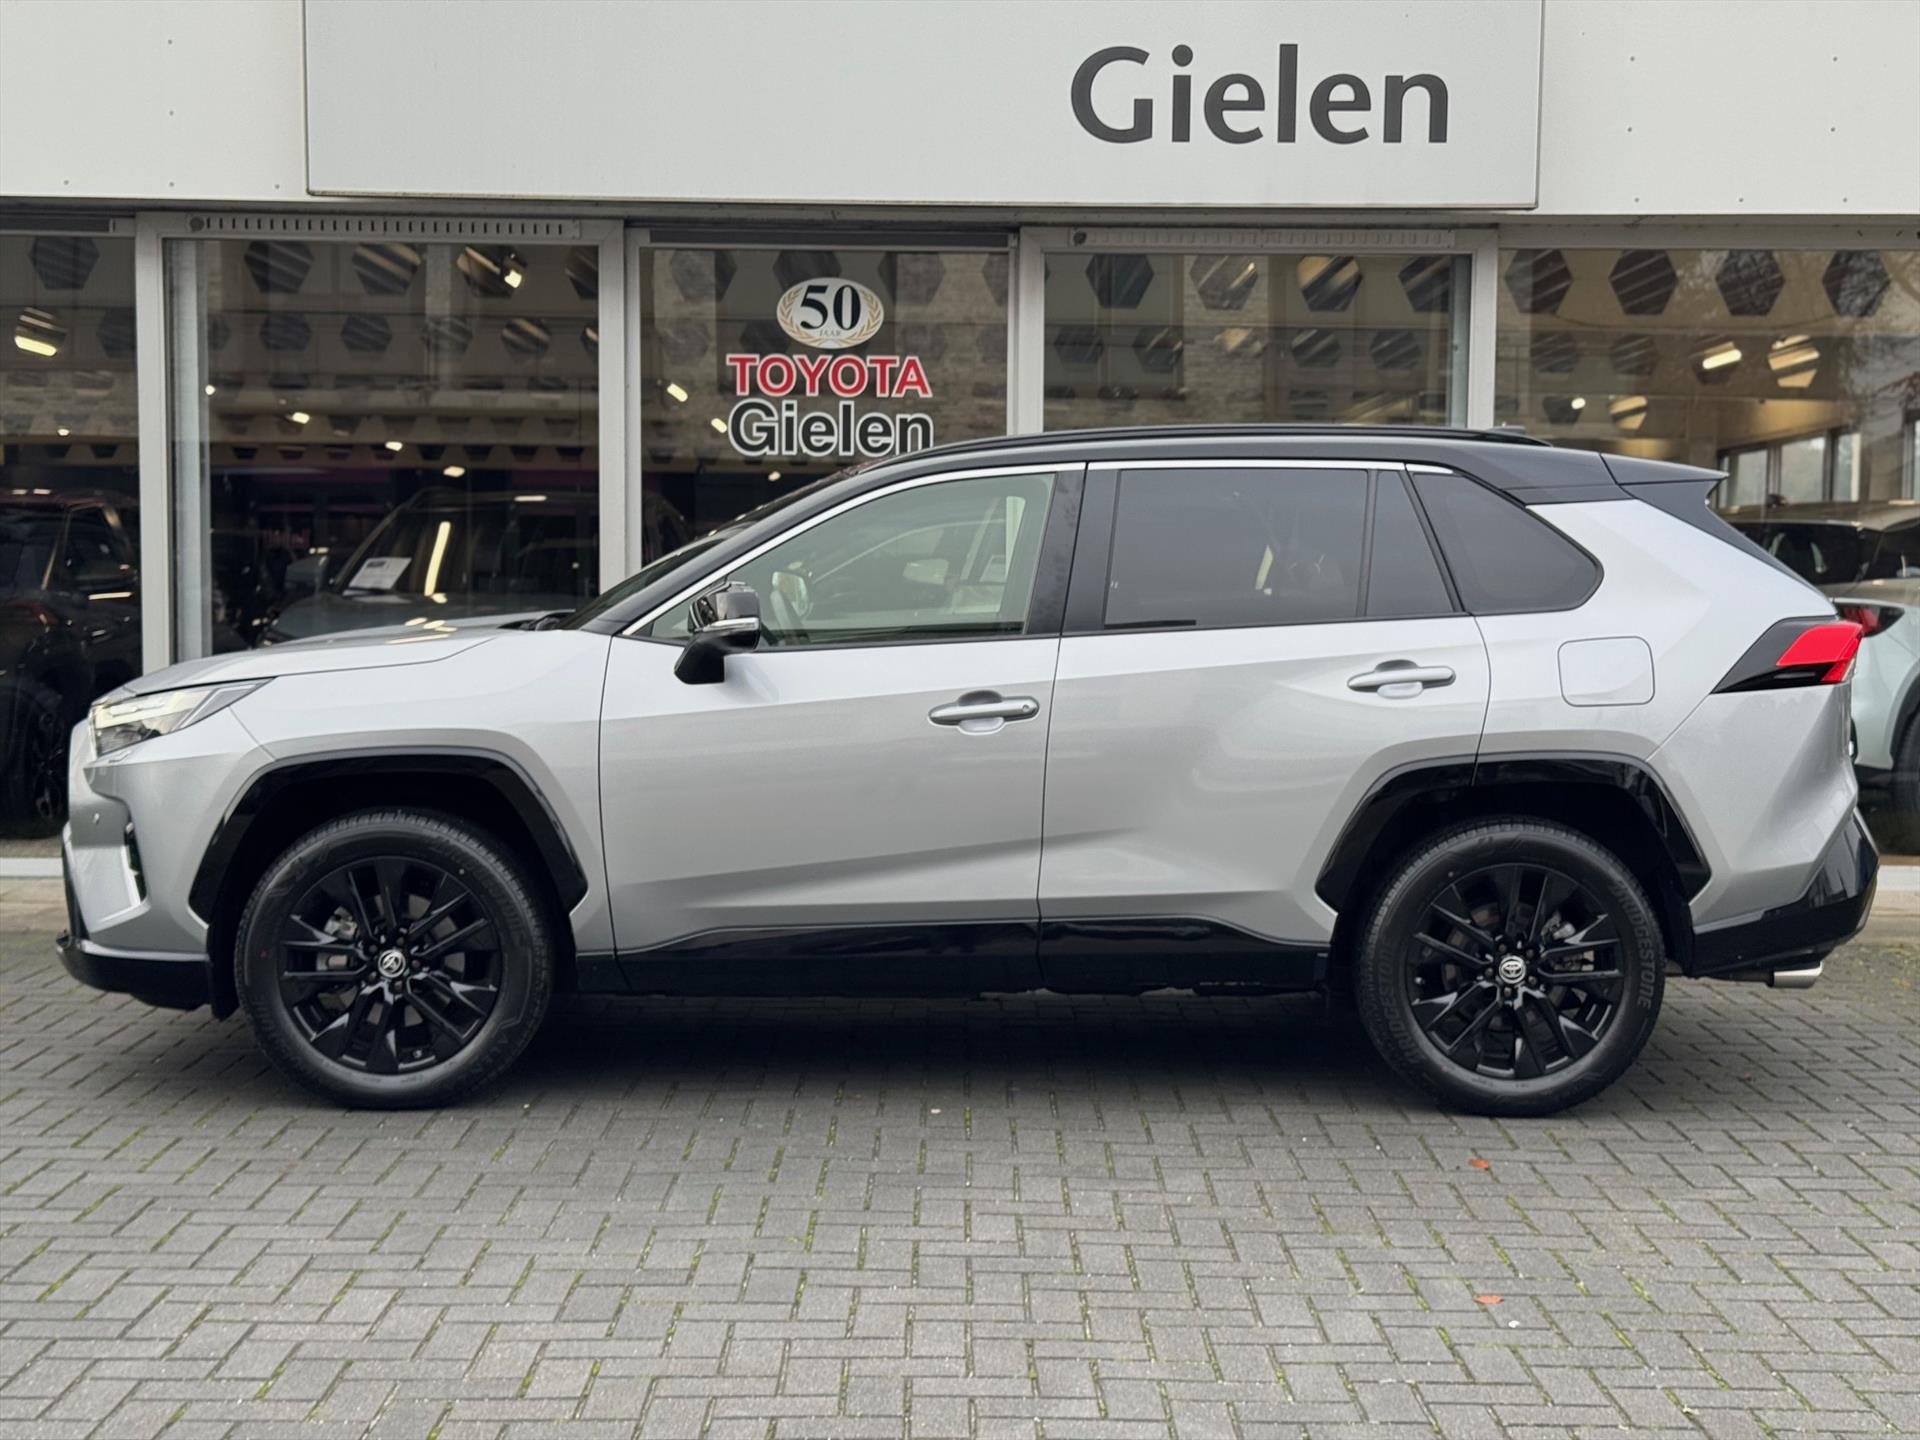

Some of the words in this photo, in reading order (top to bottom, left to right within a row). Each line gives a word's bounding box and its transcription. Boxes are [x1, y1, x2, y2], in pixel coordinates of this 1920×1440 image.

[1070, 43, 1449, 145] Gielen
[800, 284, 861, 331] 50
[726, 354, 933, 398] TOYOTA
[728, 398, 934, 457] Gielen
